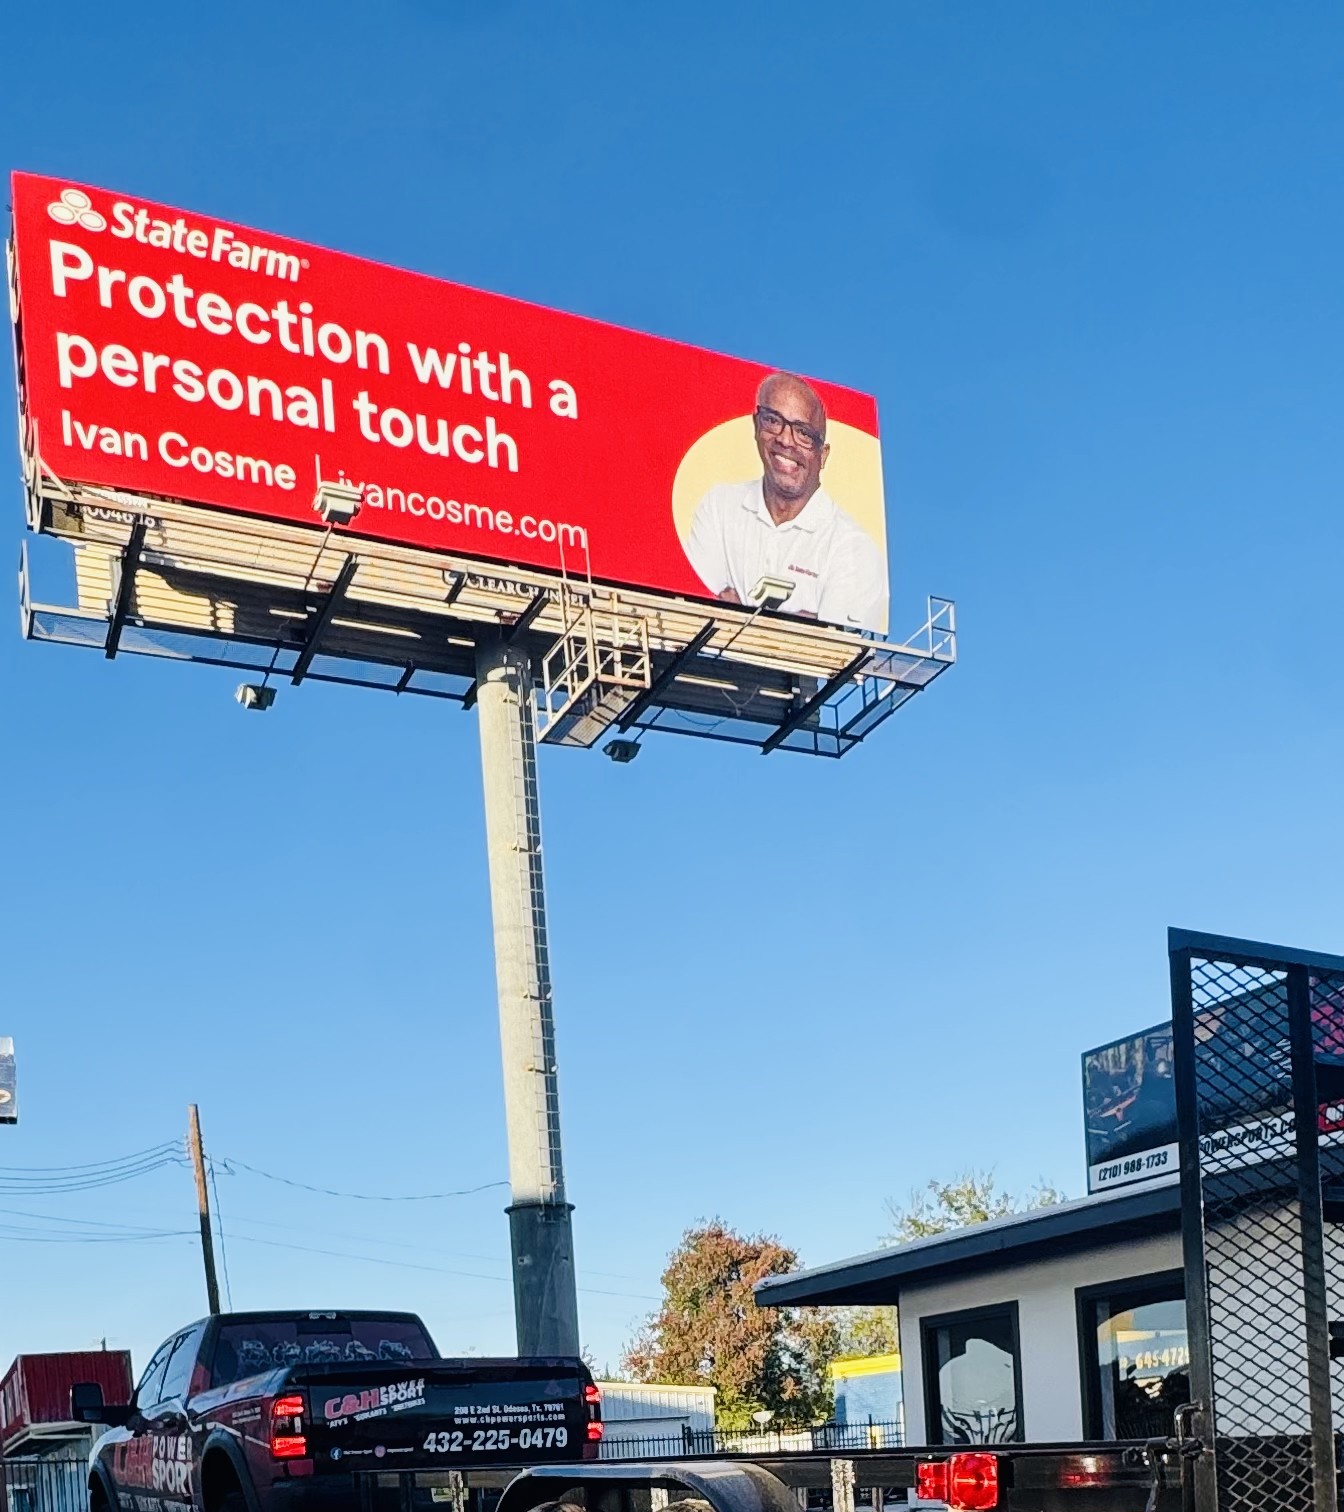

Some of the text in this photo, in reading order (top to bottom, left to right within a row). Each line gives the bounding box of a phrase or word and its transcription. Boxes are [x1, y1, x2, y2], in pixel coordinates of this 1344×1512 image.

[49, 239, 578, 420] Protection with a
[56, 331, 519, 473] personal touch
[61, 409, 149, 461] Ivan
[158, 431, 297, 490] Cosme
[1098, 1151, 1168, 1182] (210) 988-1733
[324, 1387, 380, 1420] C&H
[379, 1386, 424, 1406] SPORT
[379, 1378, 425, 1394] POWER
[423, 1427, 568, 1453] 432-225-0479
